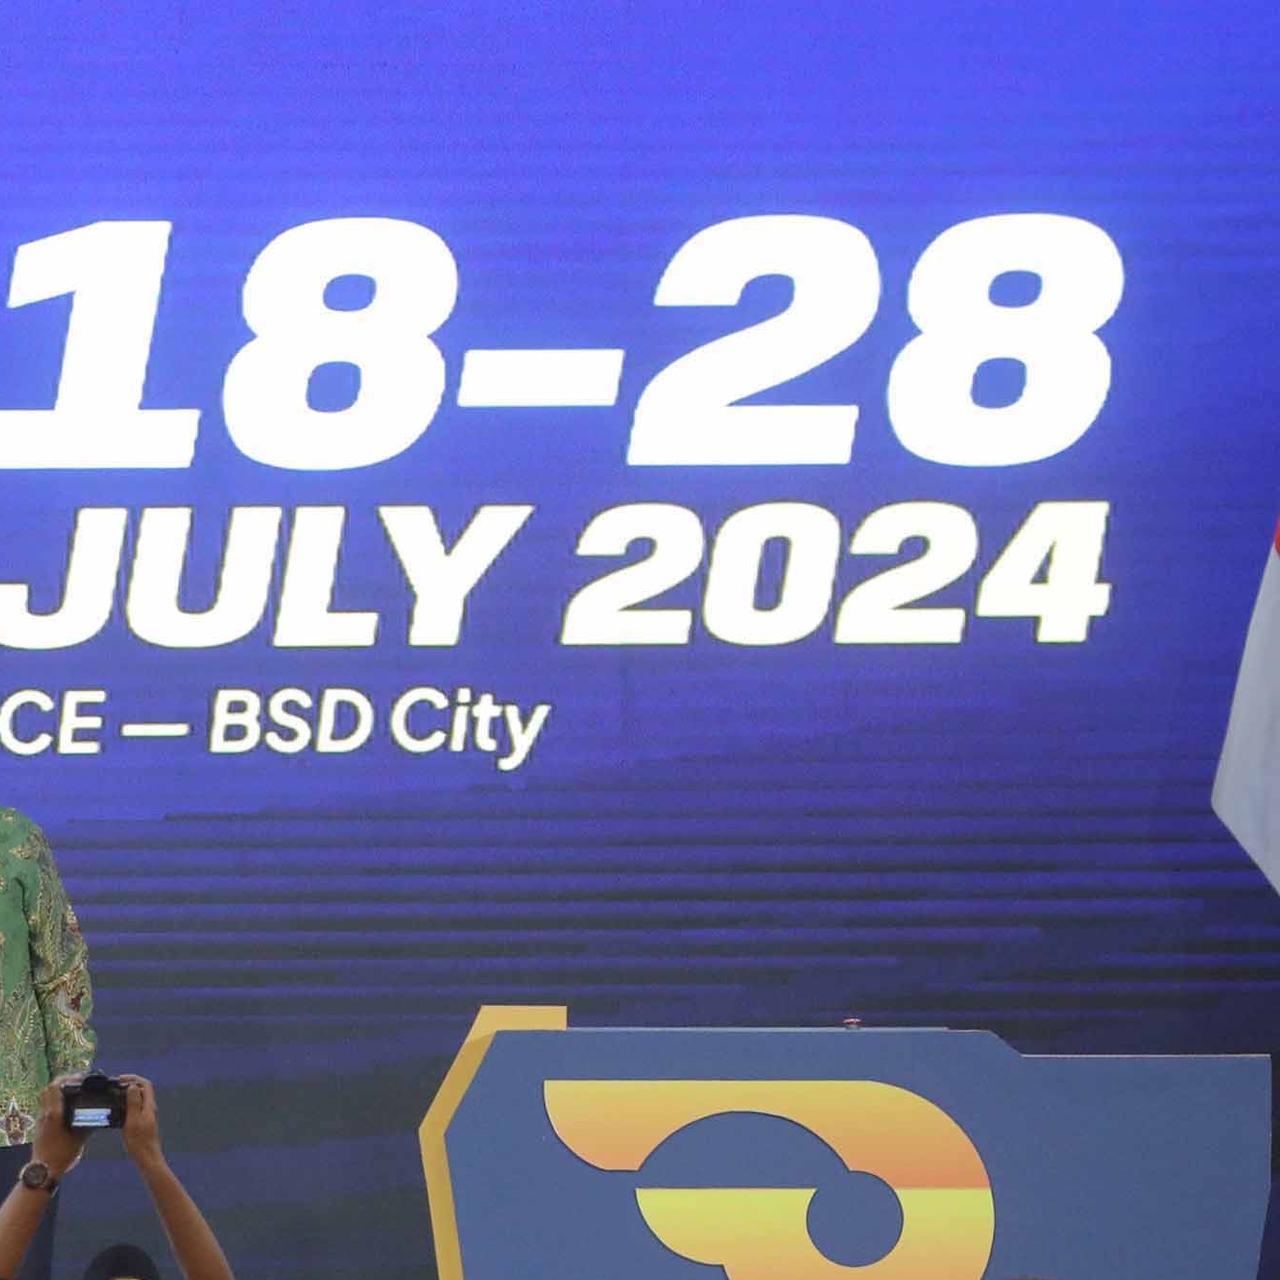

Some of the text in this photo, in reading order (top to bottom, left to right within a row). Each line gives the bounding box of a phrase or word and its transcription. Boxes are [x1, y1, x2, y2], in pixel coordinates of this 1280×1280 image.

[560, 502, 1111, 645] 2024
[209, 688, 373, 754] BSD
[389, 686, 551, 772] City
